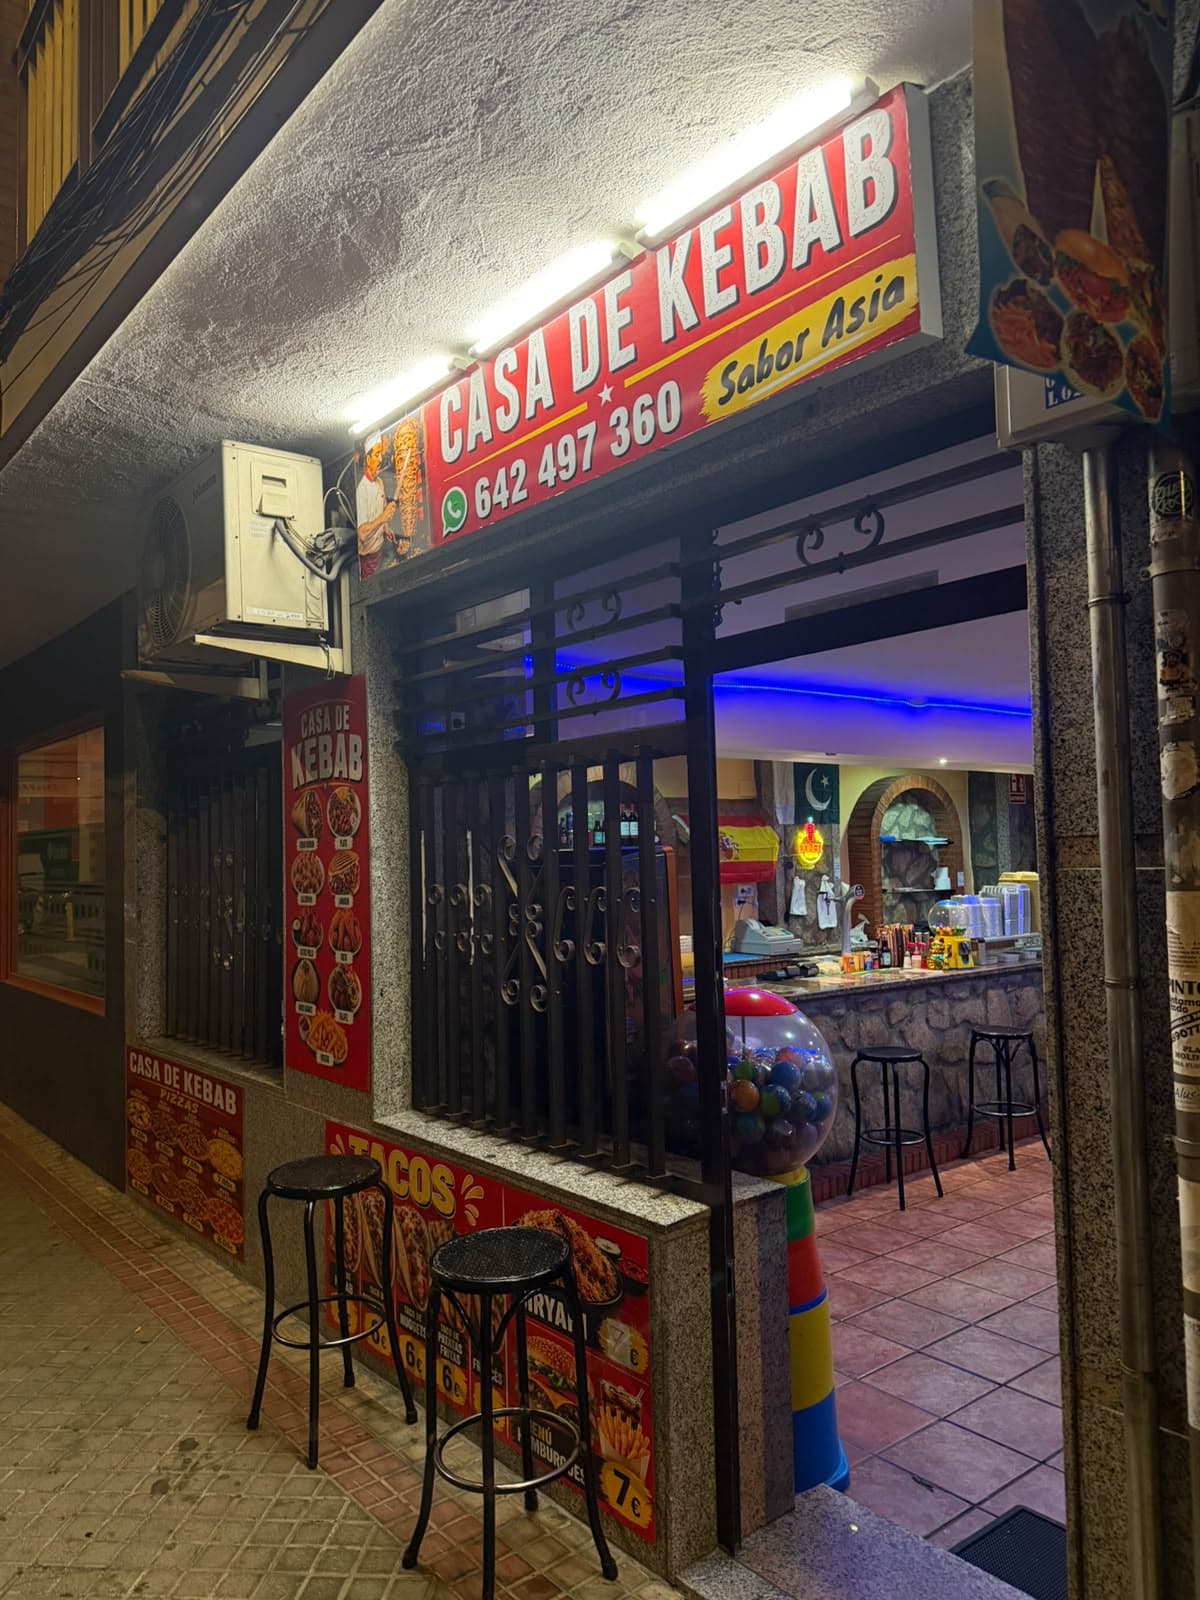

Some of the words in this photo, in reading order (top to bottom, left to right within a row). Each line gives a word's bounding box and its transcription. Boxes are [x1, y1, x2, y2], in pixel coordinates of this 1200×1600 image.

[439, 333, 554, 465] CASA
[568, 270, 637, 396] DE
[655, 106, 900, 345] KEBAB
[717, 328, 811, 407] Sabor
[821, 272, 907, 350] Asia
[474, 467, 529, 520] 642
[537, 420, 597, 490] 497
[609, 380, 683, 458] 360
[300, 705, 331, 739] CASA
[335, 704, 350, 731] DE
[290, 732, 364, 791] KEBAB
[129, 1051, 161, 1083] CASA
[163, 1063, 181, 1091] DE
[183, 1069, 237, 1116] KEBAB
[159, 1089, 200, 1114] PIZZAS
[443, 1364, 460, 1397] 6€
[613, 1468, 641, 1518] 7€
